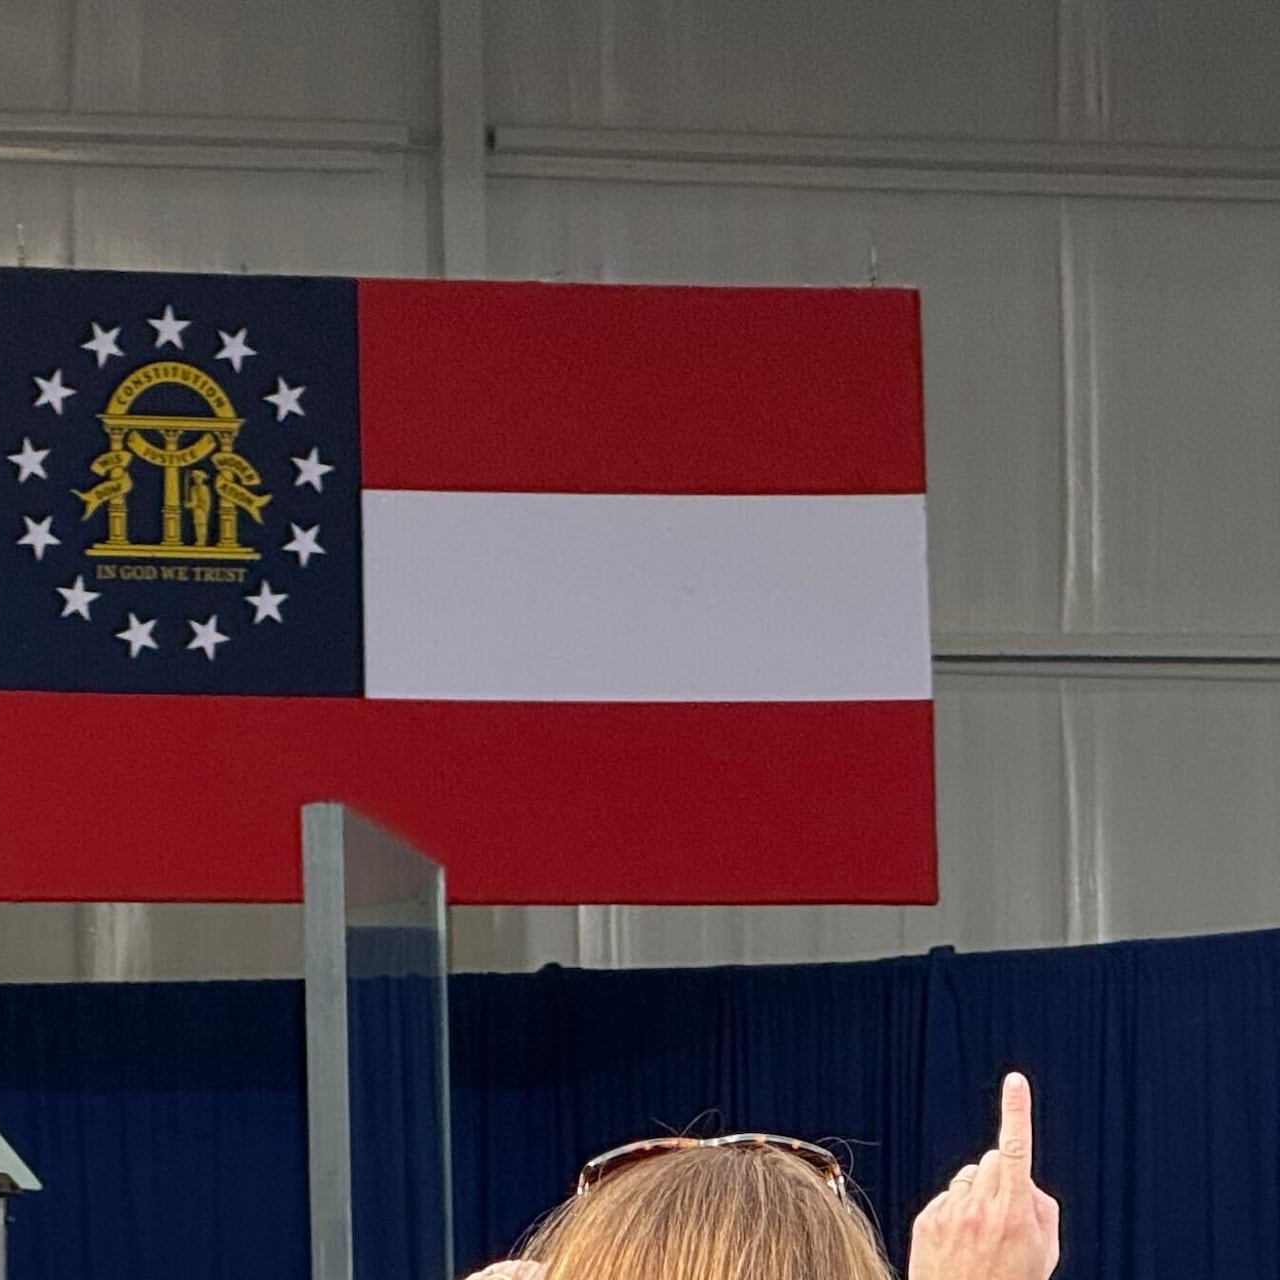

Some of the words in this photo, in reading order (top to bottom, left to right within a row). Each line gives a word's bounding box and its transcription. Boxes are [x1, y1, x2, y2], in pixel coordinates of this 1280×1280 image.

[96, 564, 117, 580] IN
[120, 565, 158, 581] GOD
[160, 566, 189, 582] WE
[192, 566, 247, 583] TRUST
